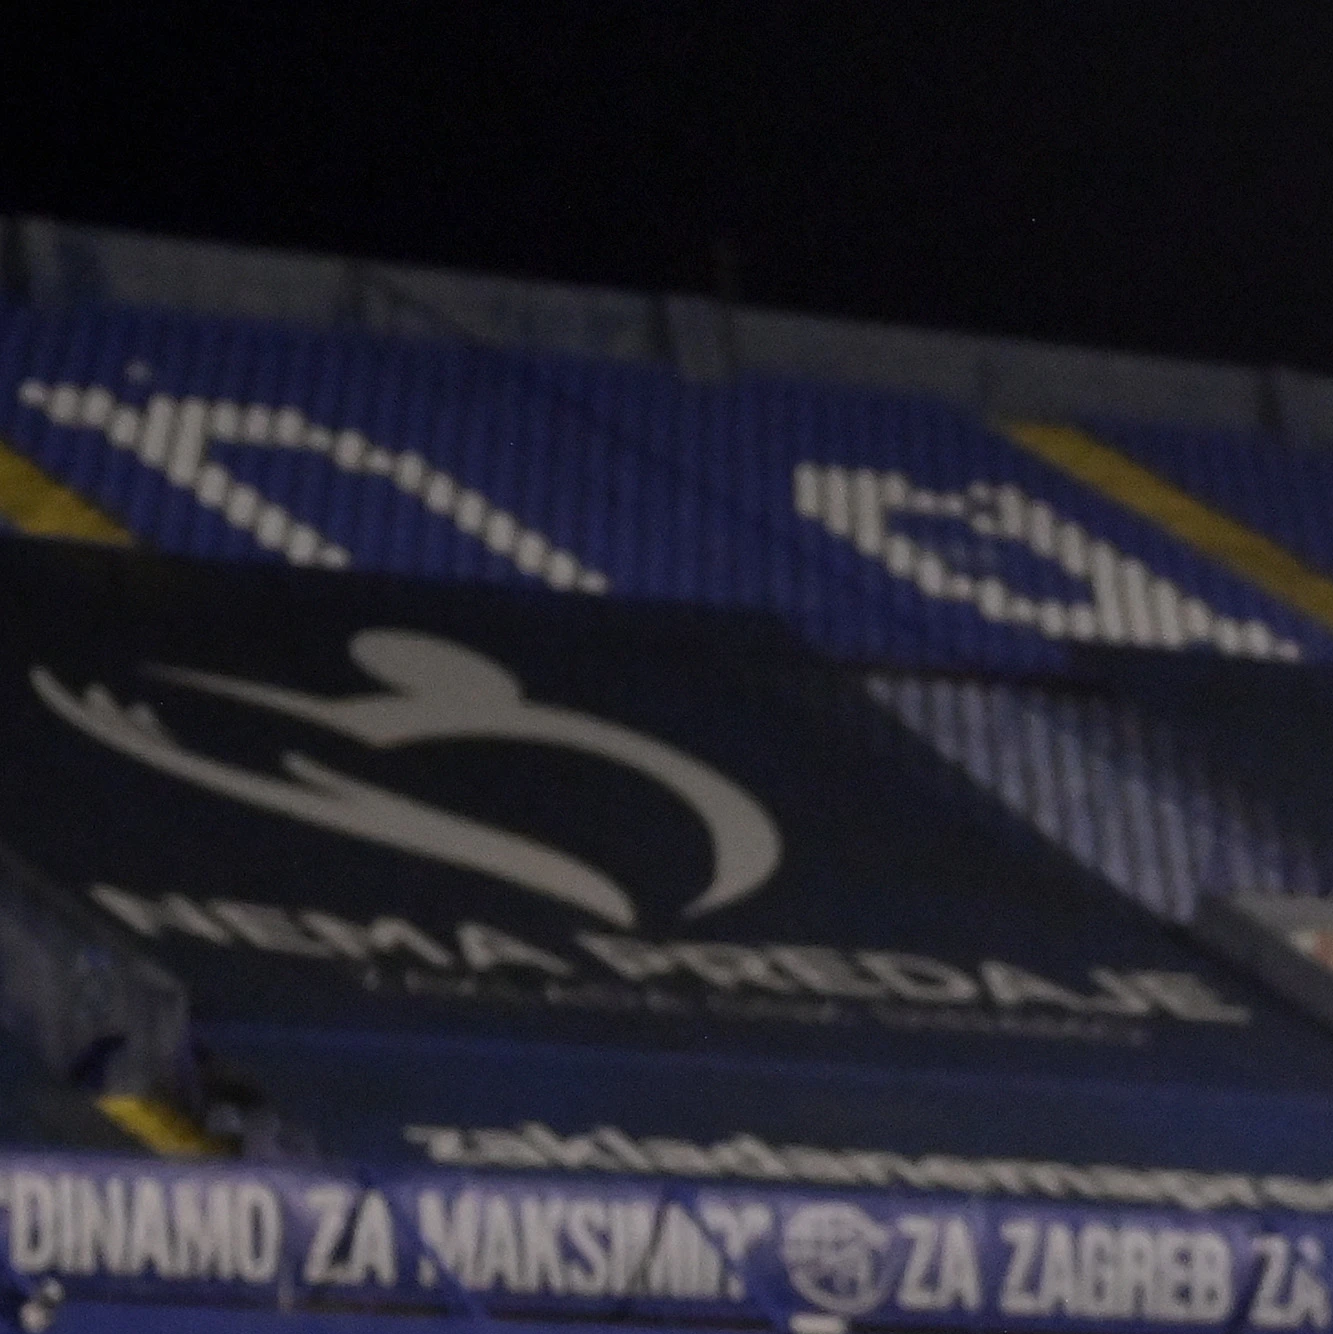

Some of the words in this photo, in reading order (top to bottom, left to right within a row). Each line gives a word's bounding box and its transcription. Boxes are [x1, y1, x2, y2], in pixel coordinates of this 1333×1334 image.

[8, 1170, 284, 1285] DINAMO
[304, 1188, 396, 1288] ZA
[899, 1212, 984, 1313] ZA
[1000, 1219, 1234, 1326] ZAGREB
[1250, 1232, 1332, 1332] ZA
